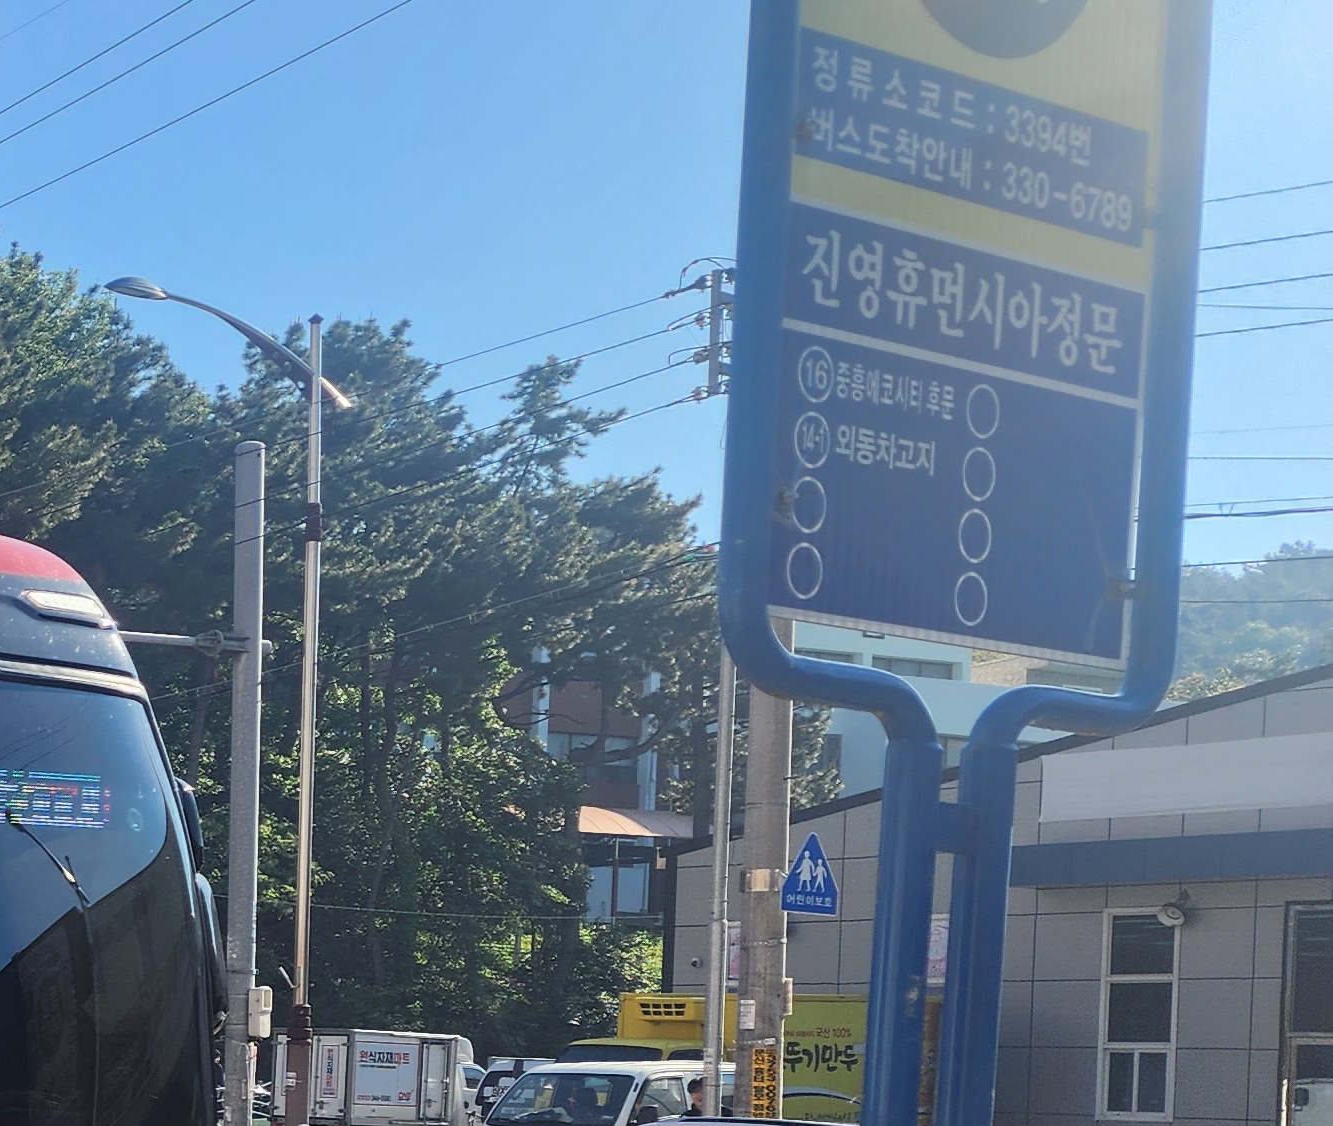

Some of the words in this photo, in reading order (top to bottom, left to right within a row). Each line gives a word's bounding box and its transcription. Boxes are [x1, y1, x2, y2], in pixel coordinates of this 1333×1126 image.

[812, 46, 976, 130] 정류소코드
[1004, 105, 1093, 167] 3394번
[807, 107, 973, 191] 버스도착안내
[1001, 162, 1134, 232] 330-6789
[801, 229, 1123, 375] 진영휴먼시아정문
[805, 357, 829, 391] 16
[835, 424, 936, 477] 외동차고지
[786, 893, 833, 908] 어린이보호
